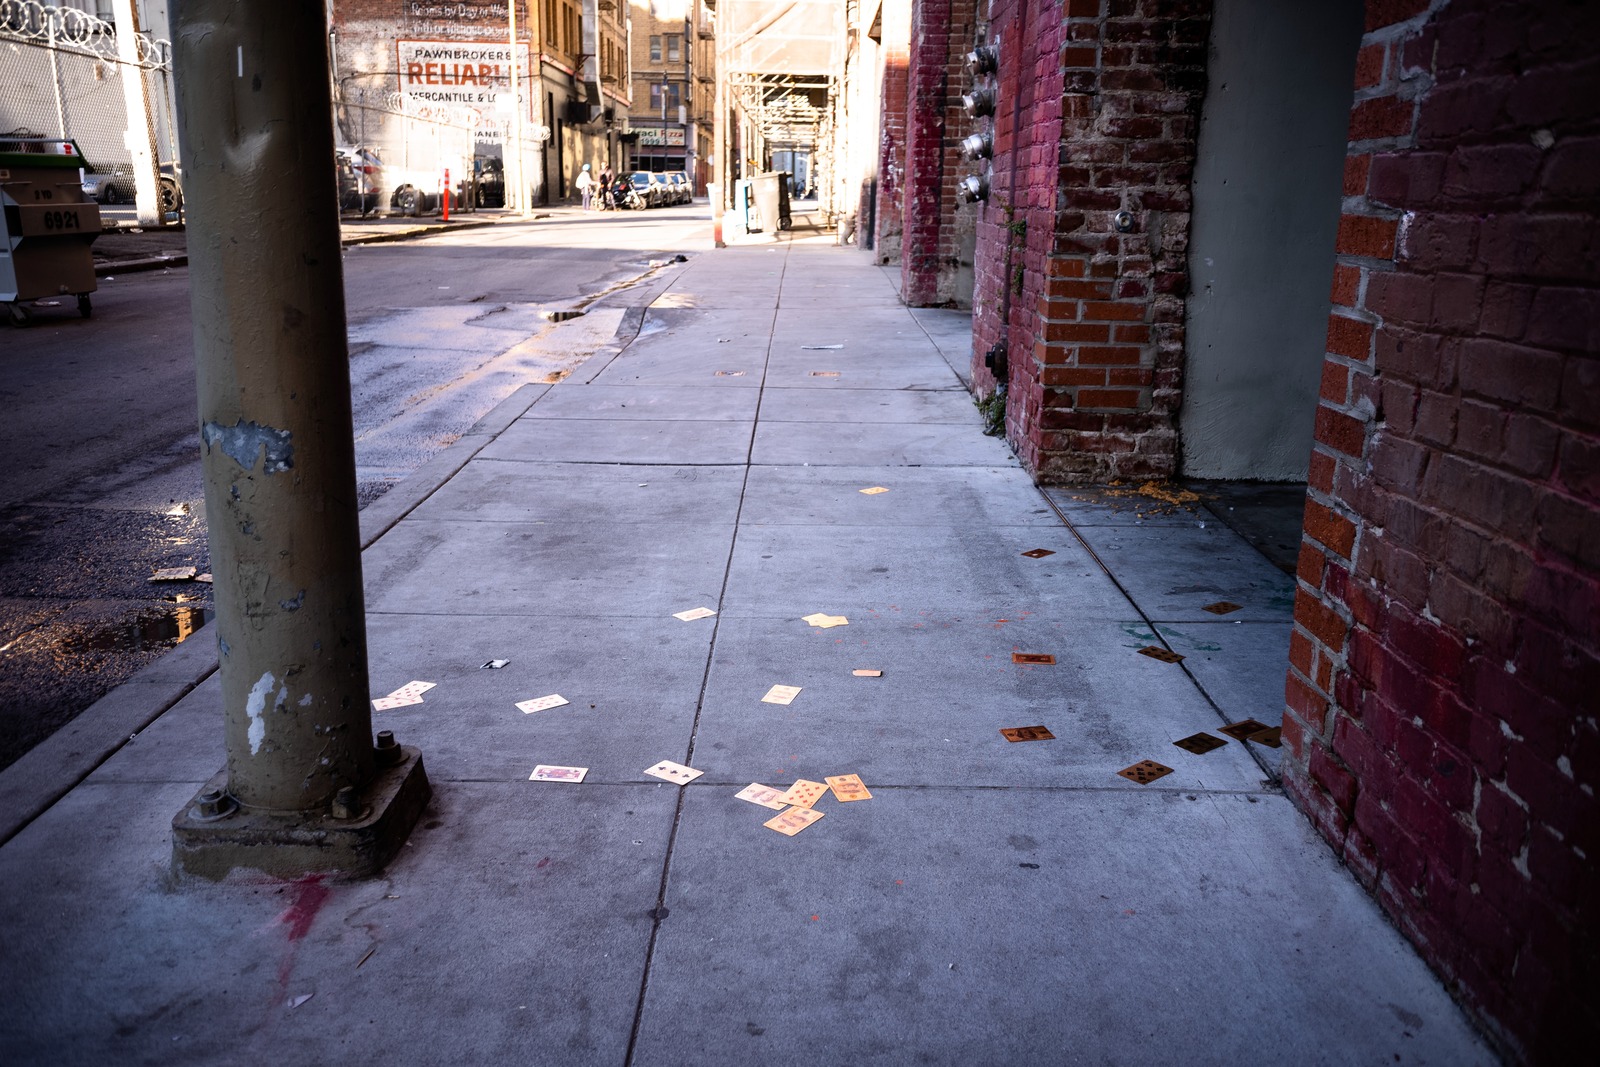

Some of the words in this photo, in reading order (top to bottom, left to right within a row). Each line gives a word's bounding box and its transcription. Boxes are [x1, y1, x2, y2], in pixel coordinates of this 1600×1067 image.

[444, 6, 457, 17] by
[458, 3, 478, 19] Day
[477, 93, 485, 102] &
[44, 211, 80, 229] 6921
